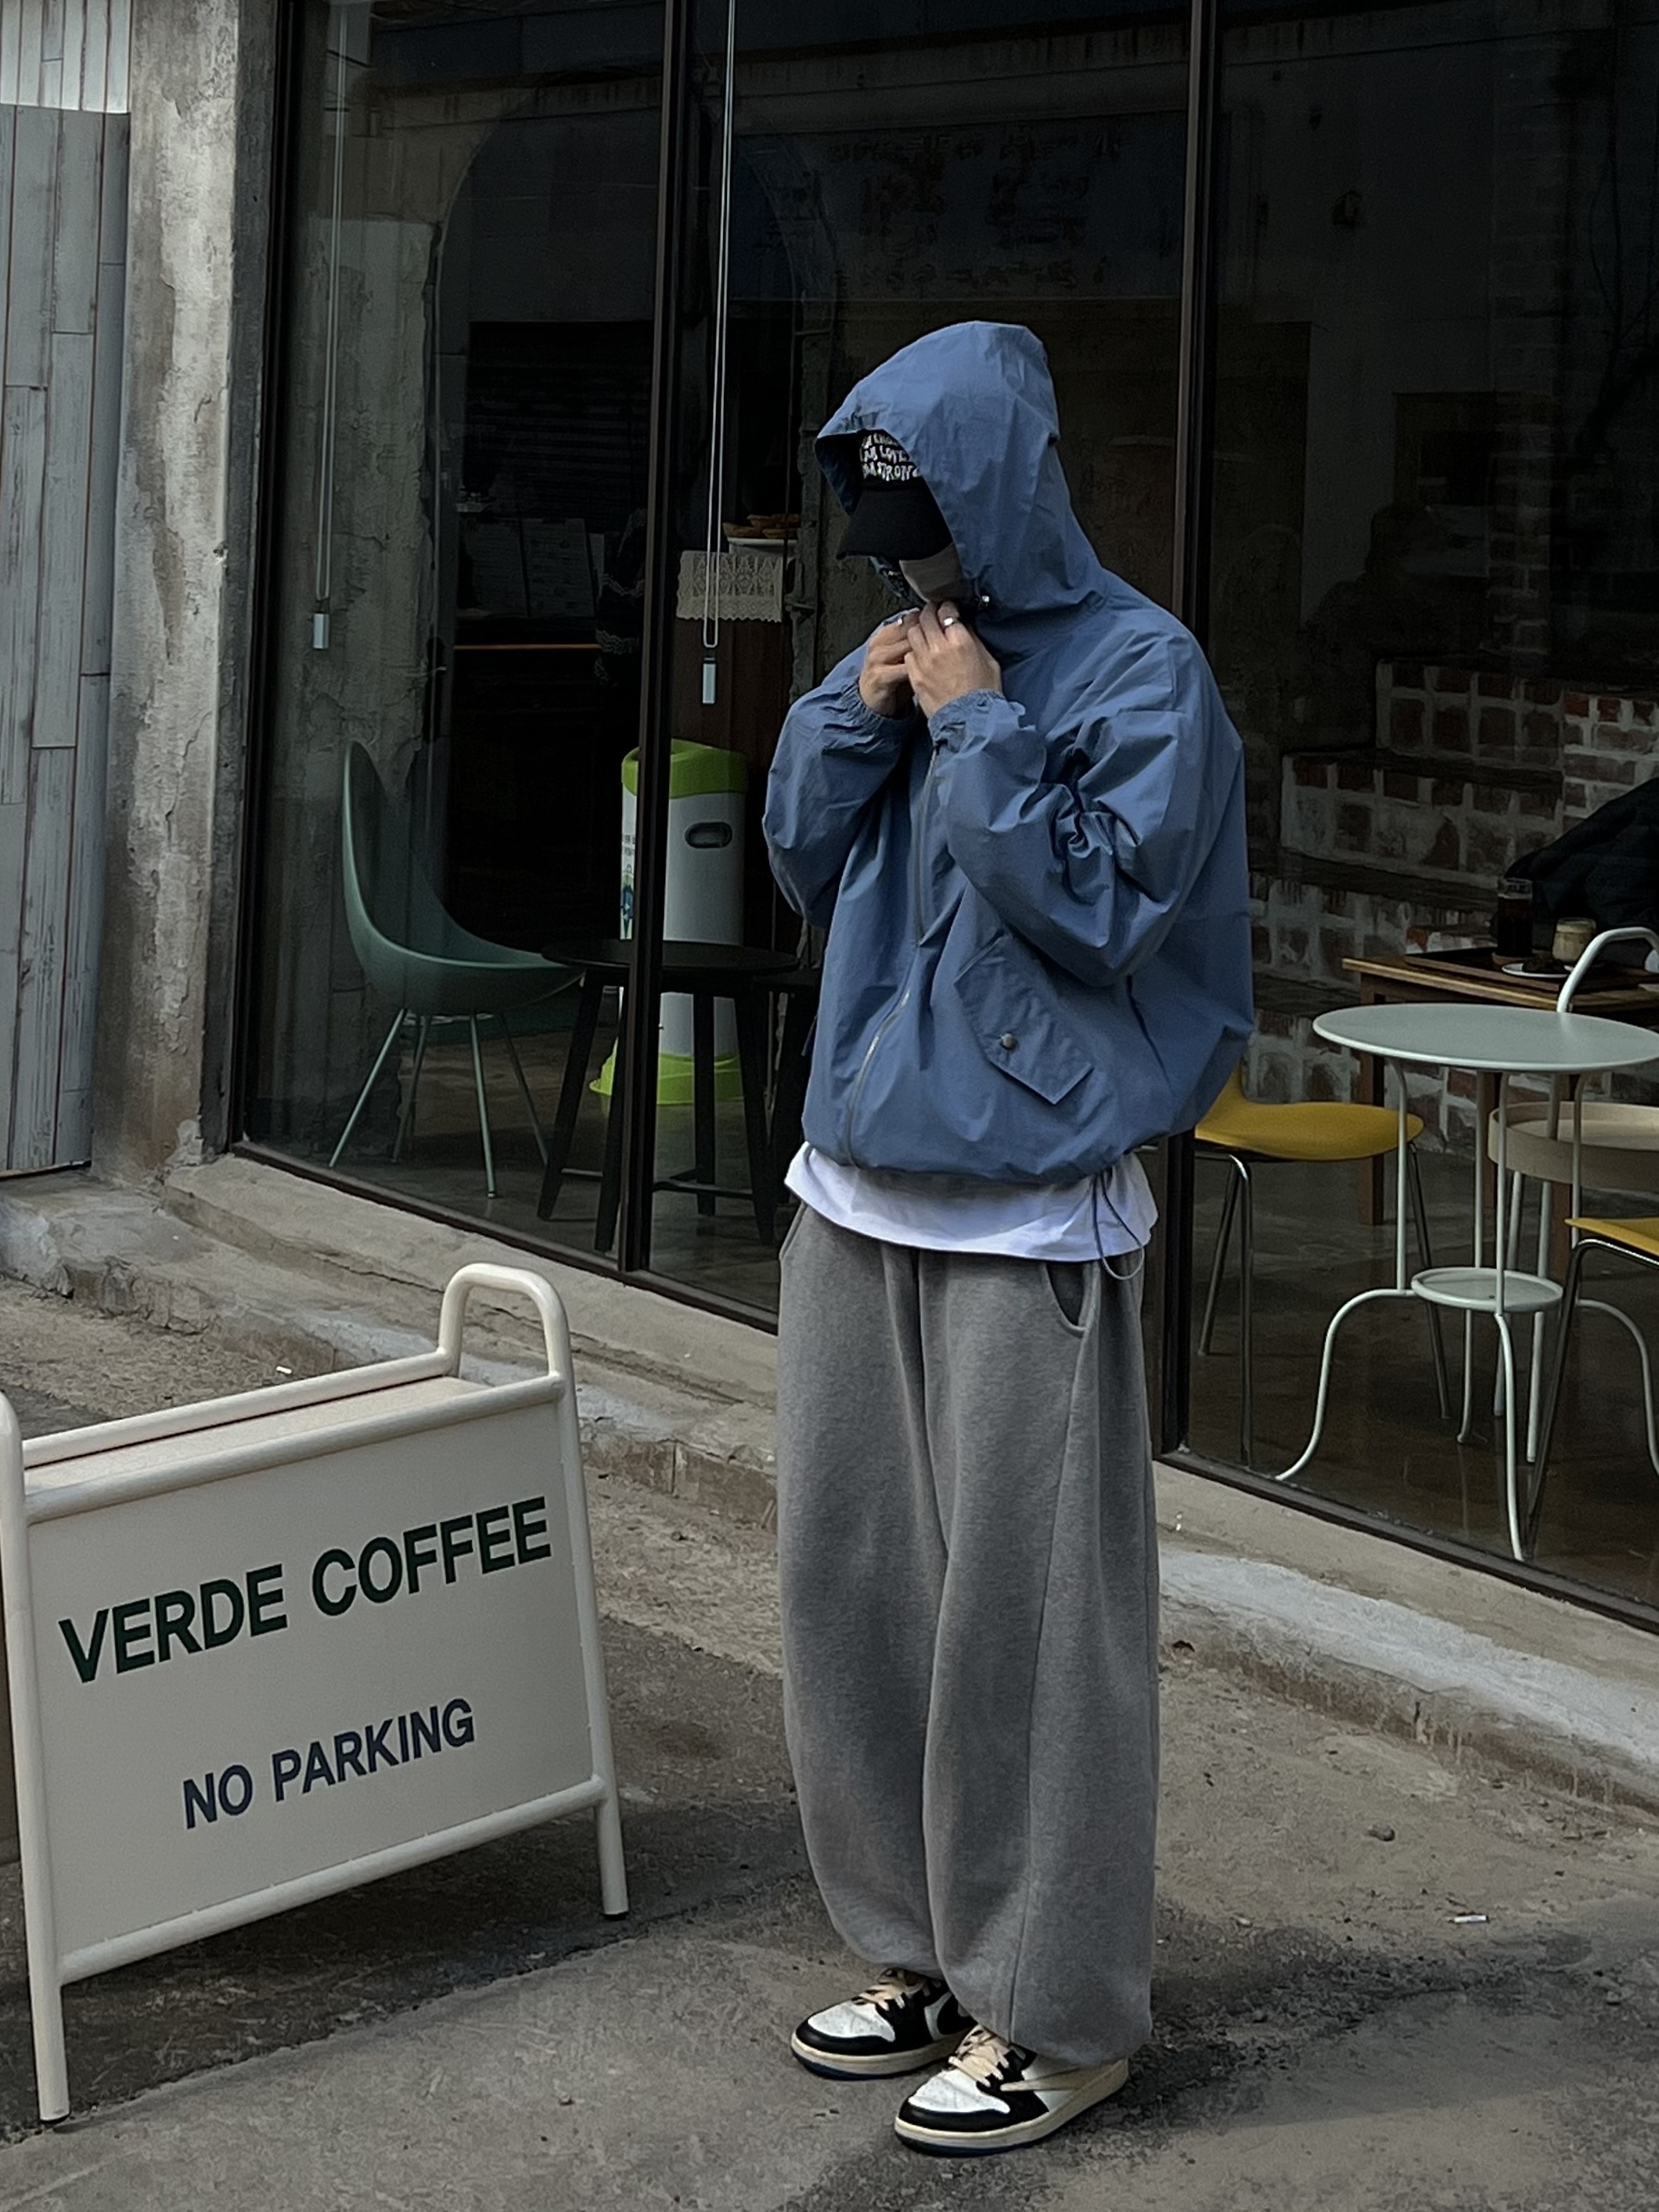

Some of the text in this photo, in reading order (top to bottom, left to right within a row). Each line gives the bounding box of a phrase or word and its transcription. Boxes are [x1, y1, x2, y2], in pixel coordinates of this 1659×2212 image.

[59, 1496, 551, 1683] VERDE COFFEE
[183, 1699, 475, 1829] NO PARKING
